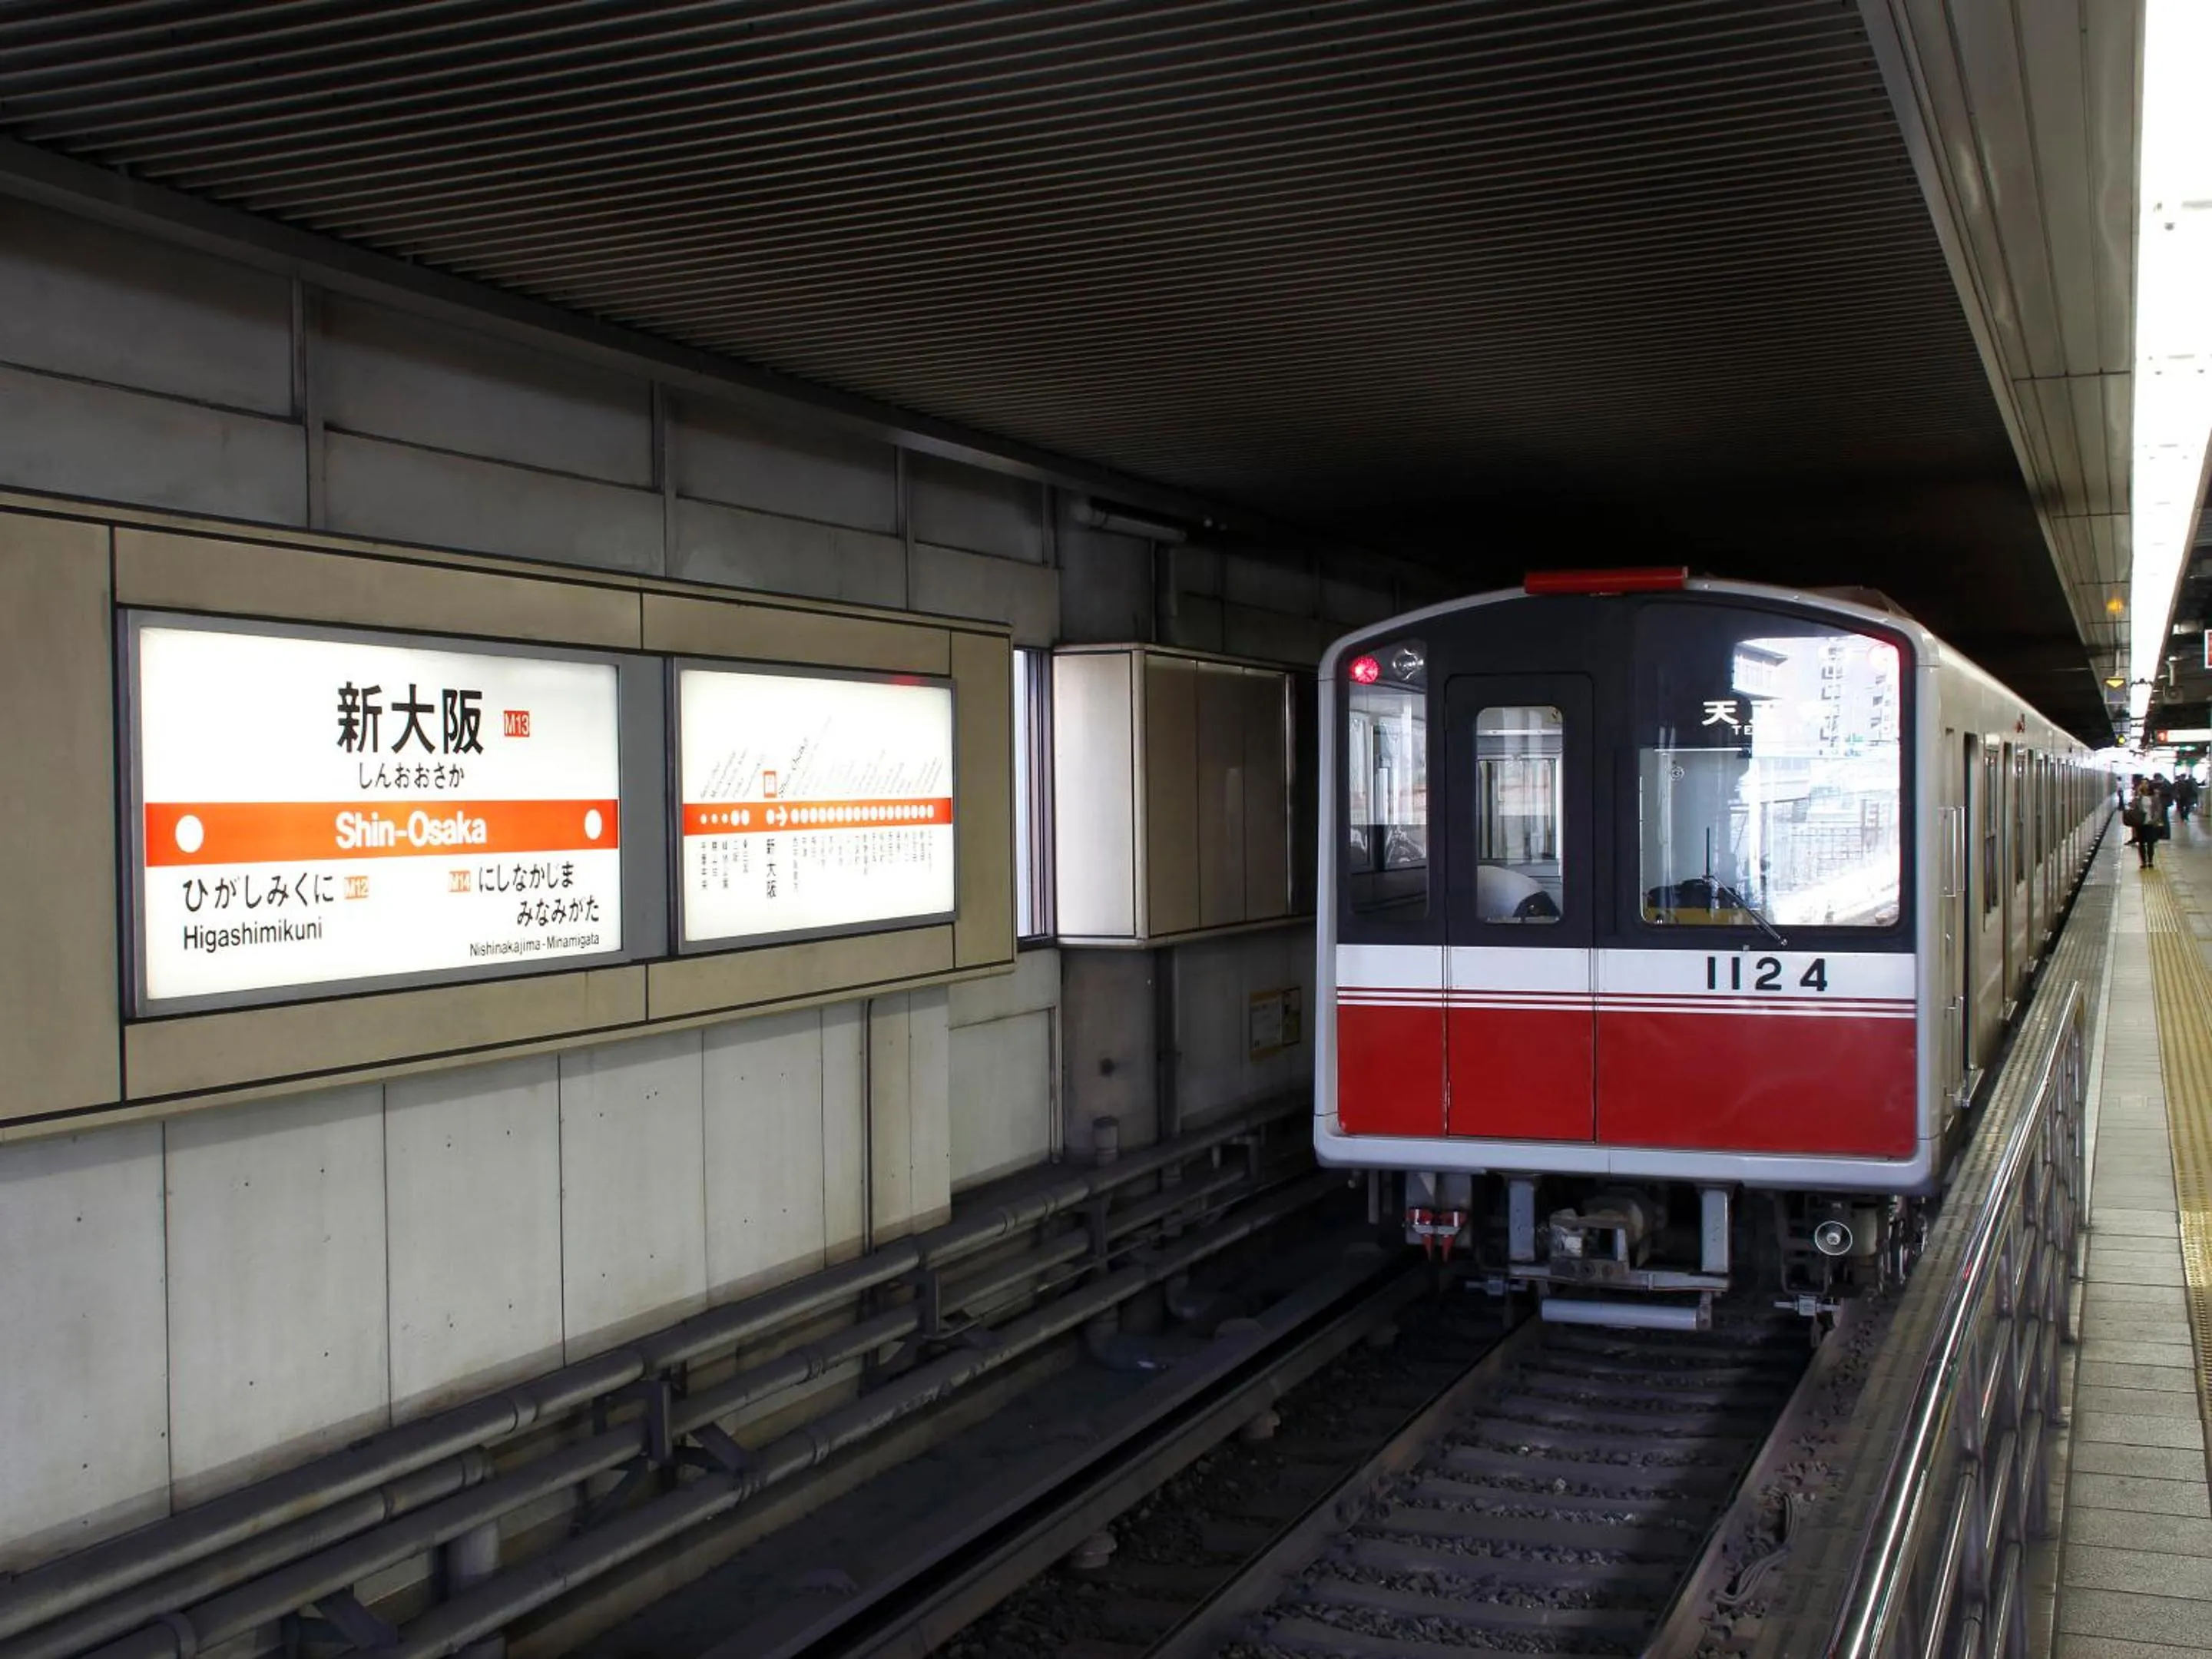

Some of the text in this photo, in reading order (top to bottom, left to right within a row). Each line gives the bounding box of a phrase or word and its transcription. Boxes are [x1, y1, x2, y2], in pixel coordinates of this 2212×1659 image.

[336, 680, 530, 755] 新大阪 M13
[359, 761, 465, 790] しんおおさか
[335, 809, 488, 849] Shin-Osaka
[182, 872, 335, 912] ひがしみくに
[478, 860, 575, 893] にしなかじま
[517, 894, 600, 927] みなみがた
[183, 916, 323, 953] Higashimikuni
[1707, 956, 1828, 992] 1124
